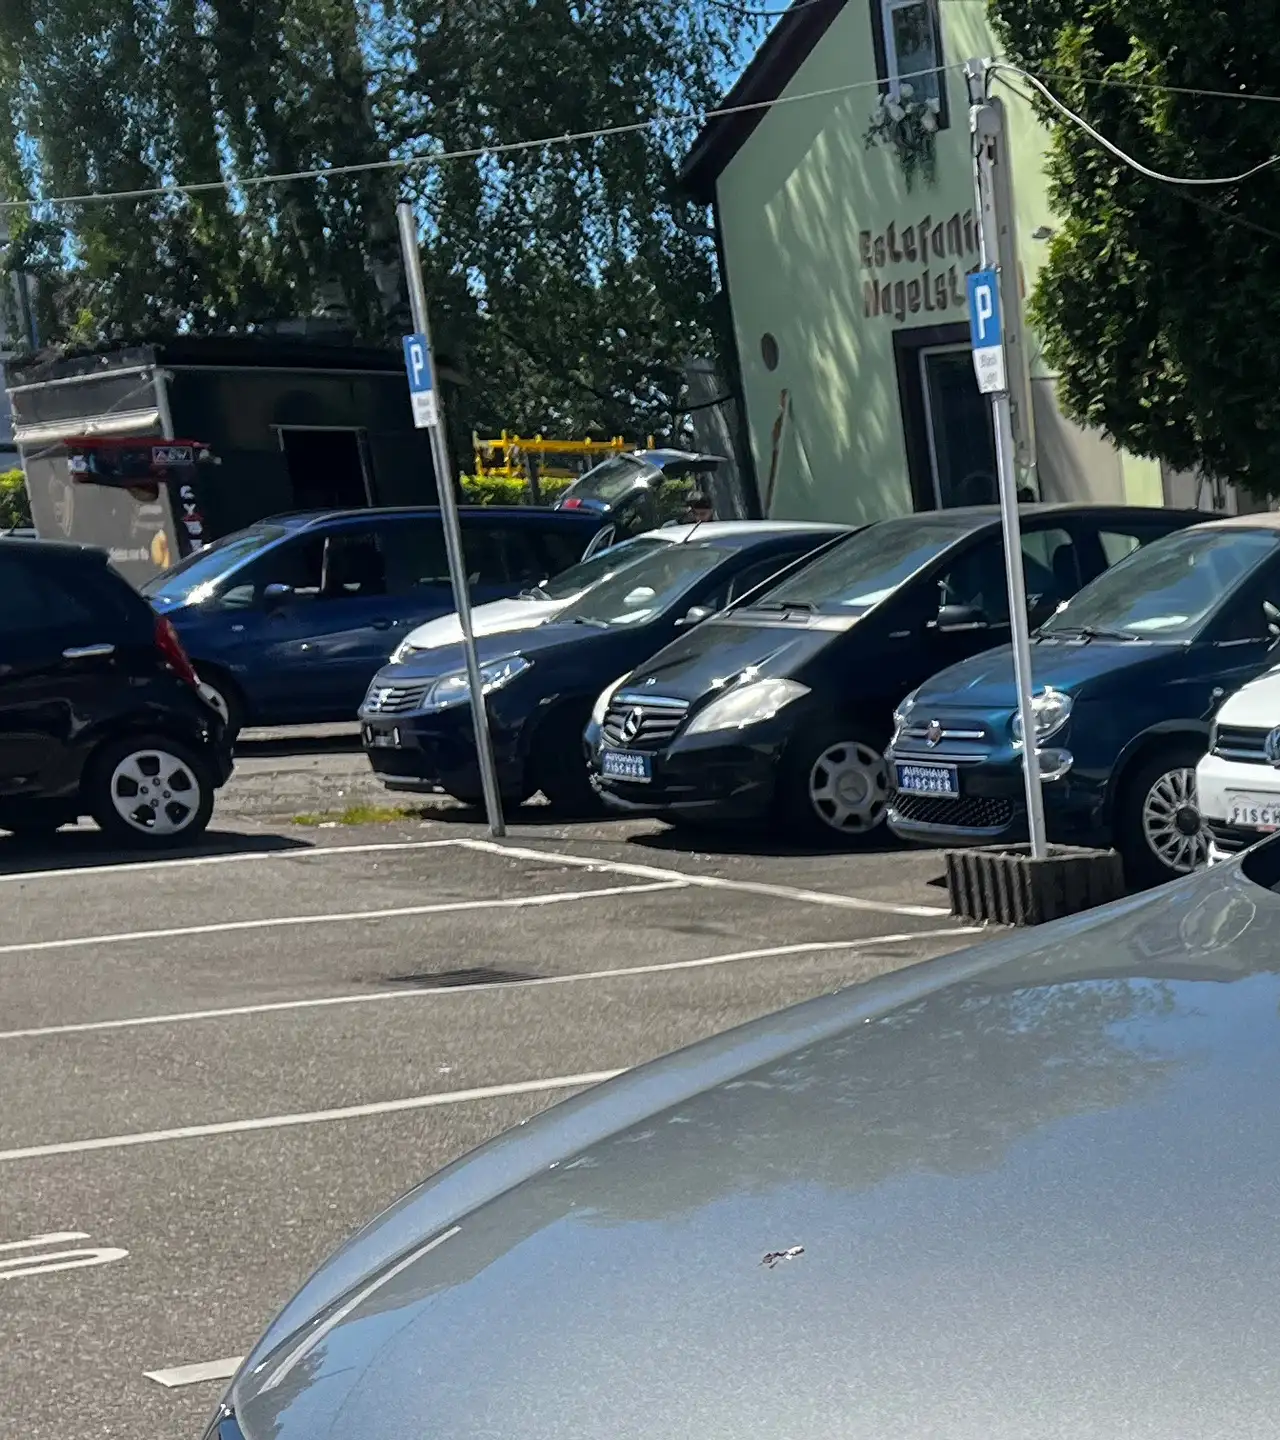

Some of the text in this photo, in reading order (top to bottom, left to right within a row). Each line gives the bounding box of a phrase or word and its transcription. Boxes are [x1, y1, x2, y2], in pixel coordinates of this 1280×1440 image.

[974, 284, 993, 340] P
[410, 343, 424, 386] P
[903, 766, 949, 779] AUTOHAUS
[903, 776, 952, 792] FISCHER
